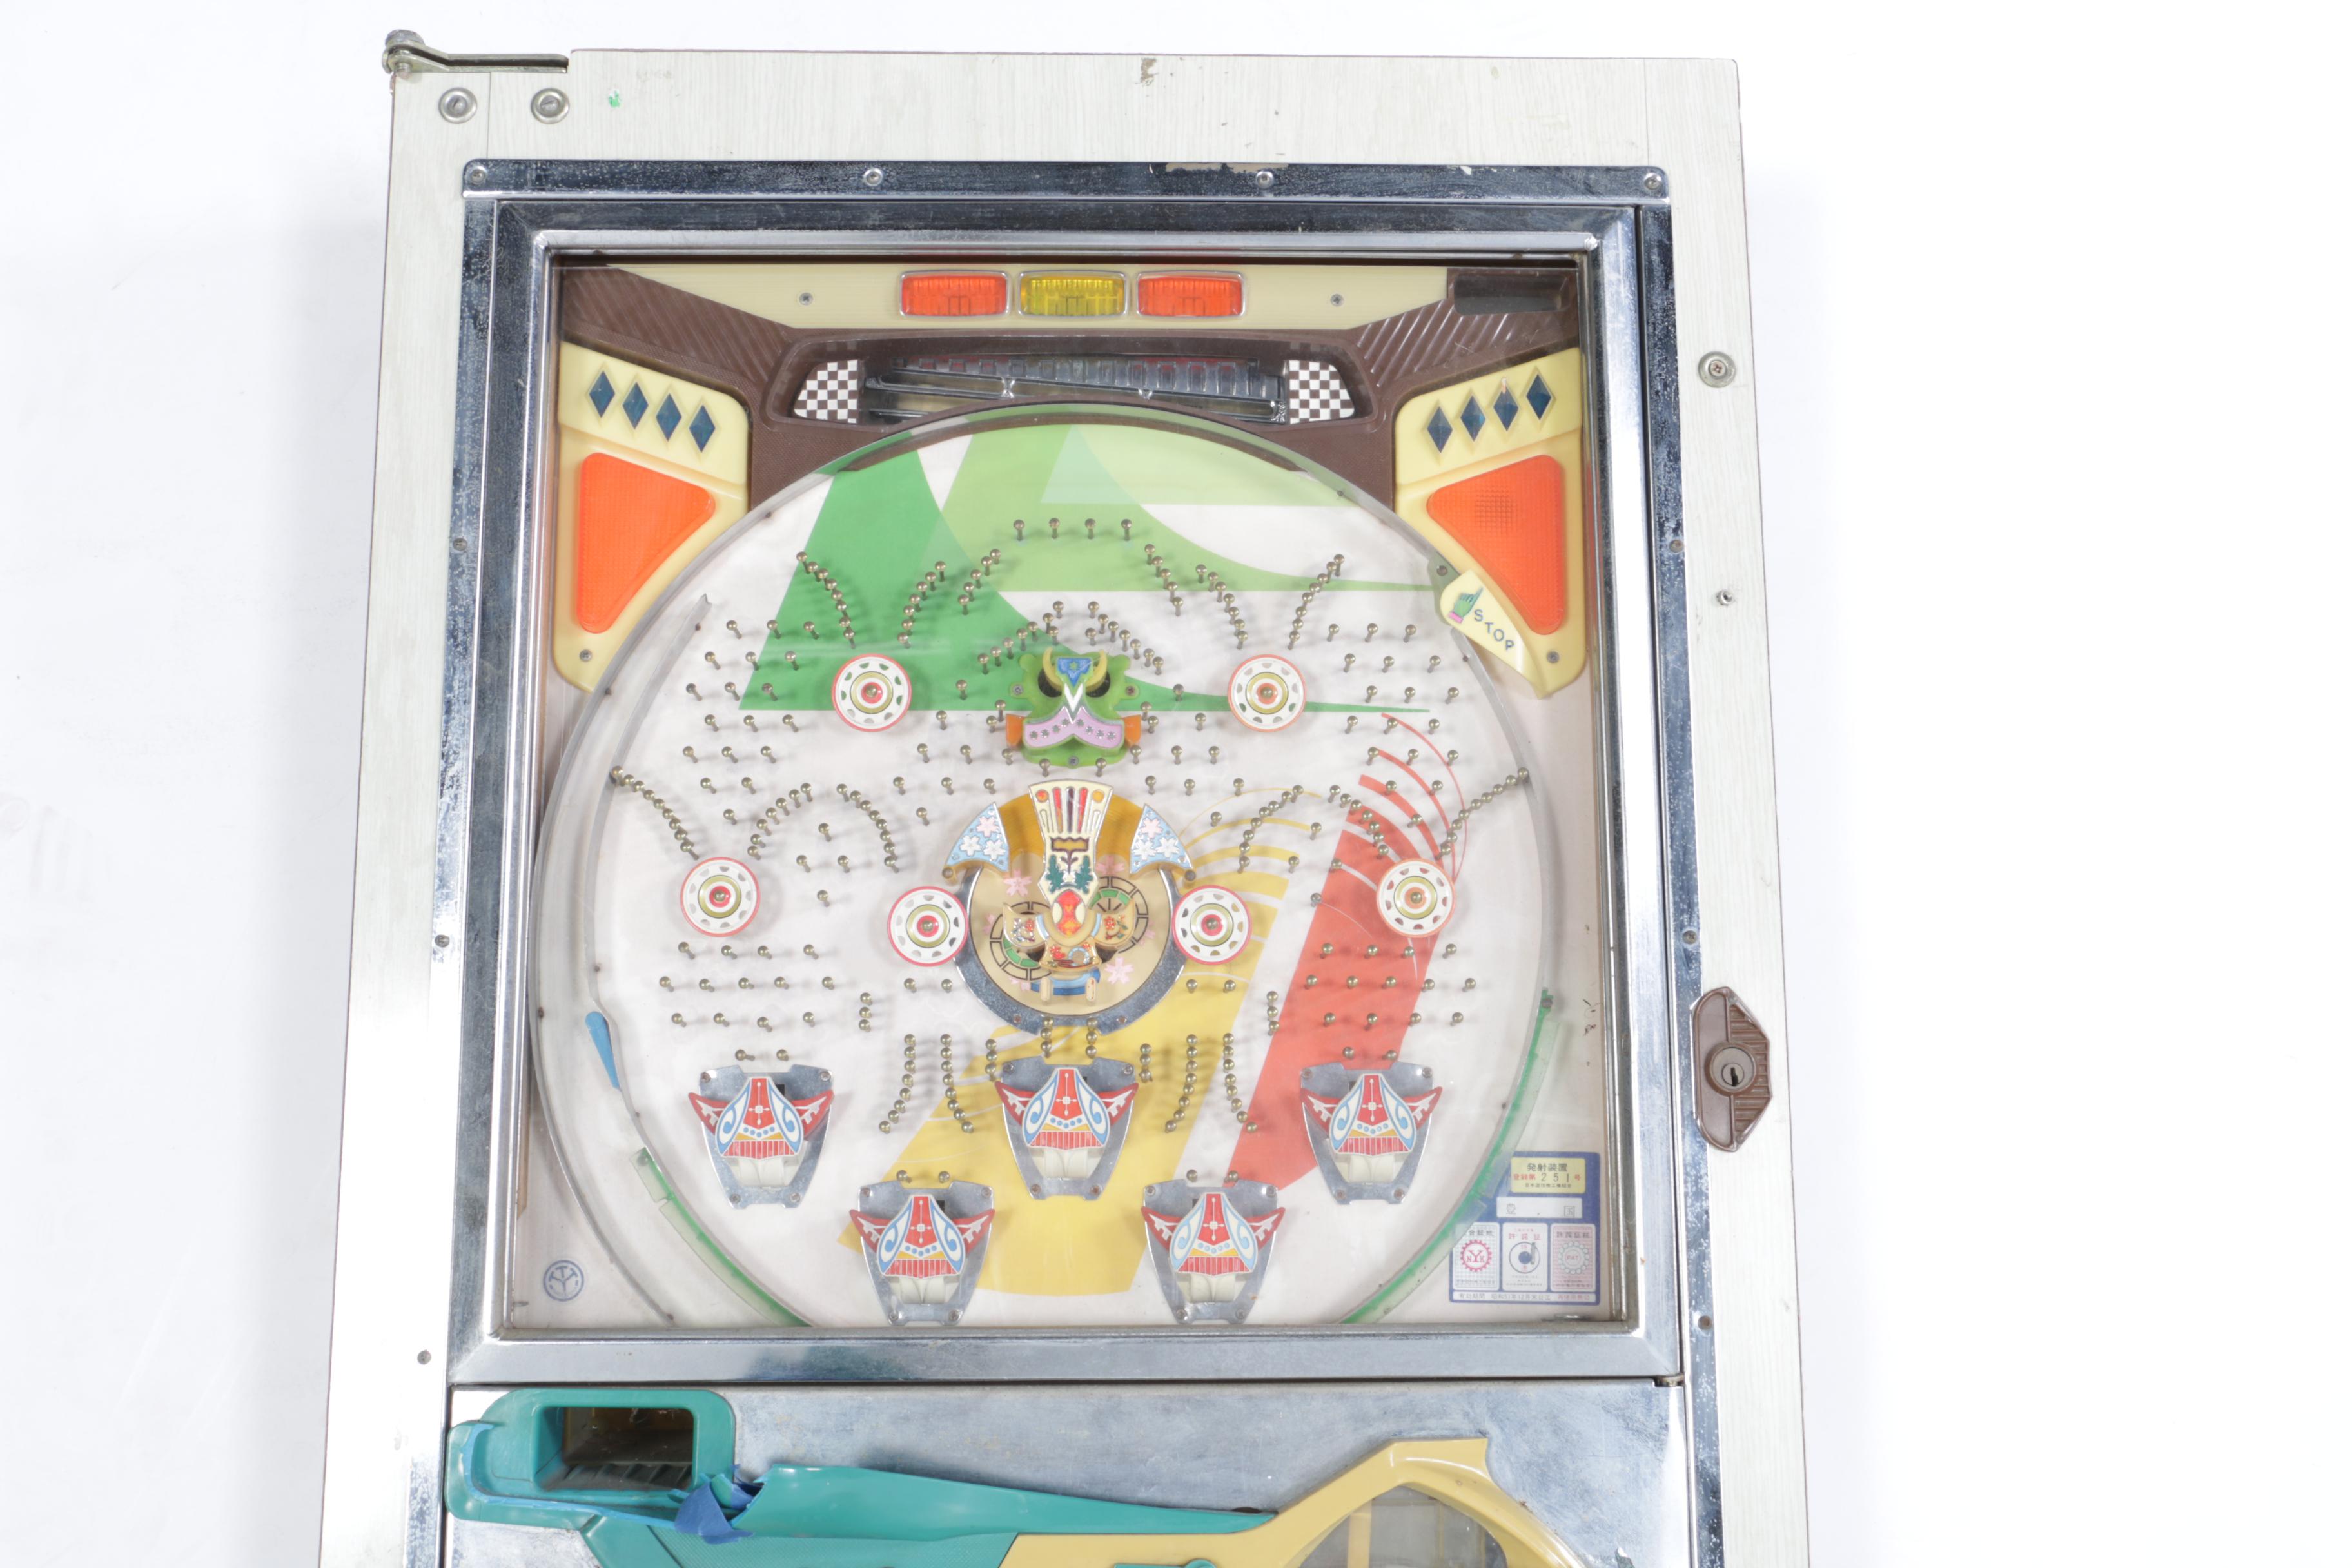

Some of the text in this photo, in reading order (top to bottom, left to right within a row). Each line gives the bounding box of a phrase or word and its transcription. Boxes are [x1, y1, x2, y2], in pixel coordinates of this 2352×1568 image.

[1474, 609, 1514, 651] STOP
[1527, 1163, 1567, 1172] 発射装置
